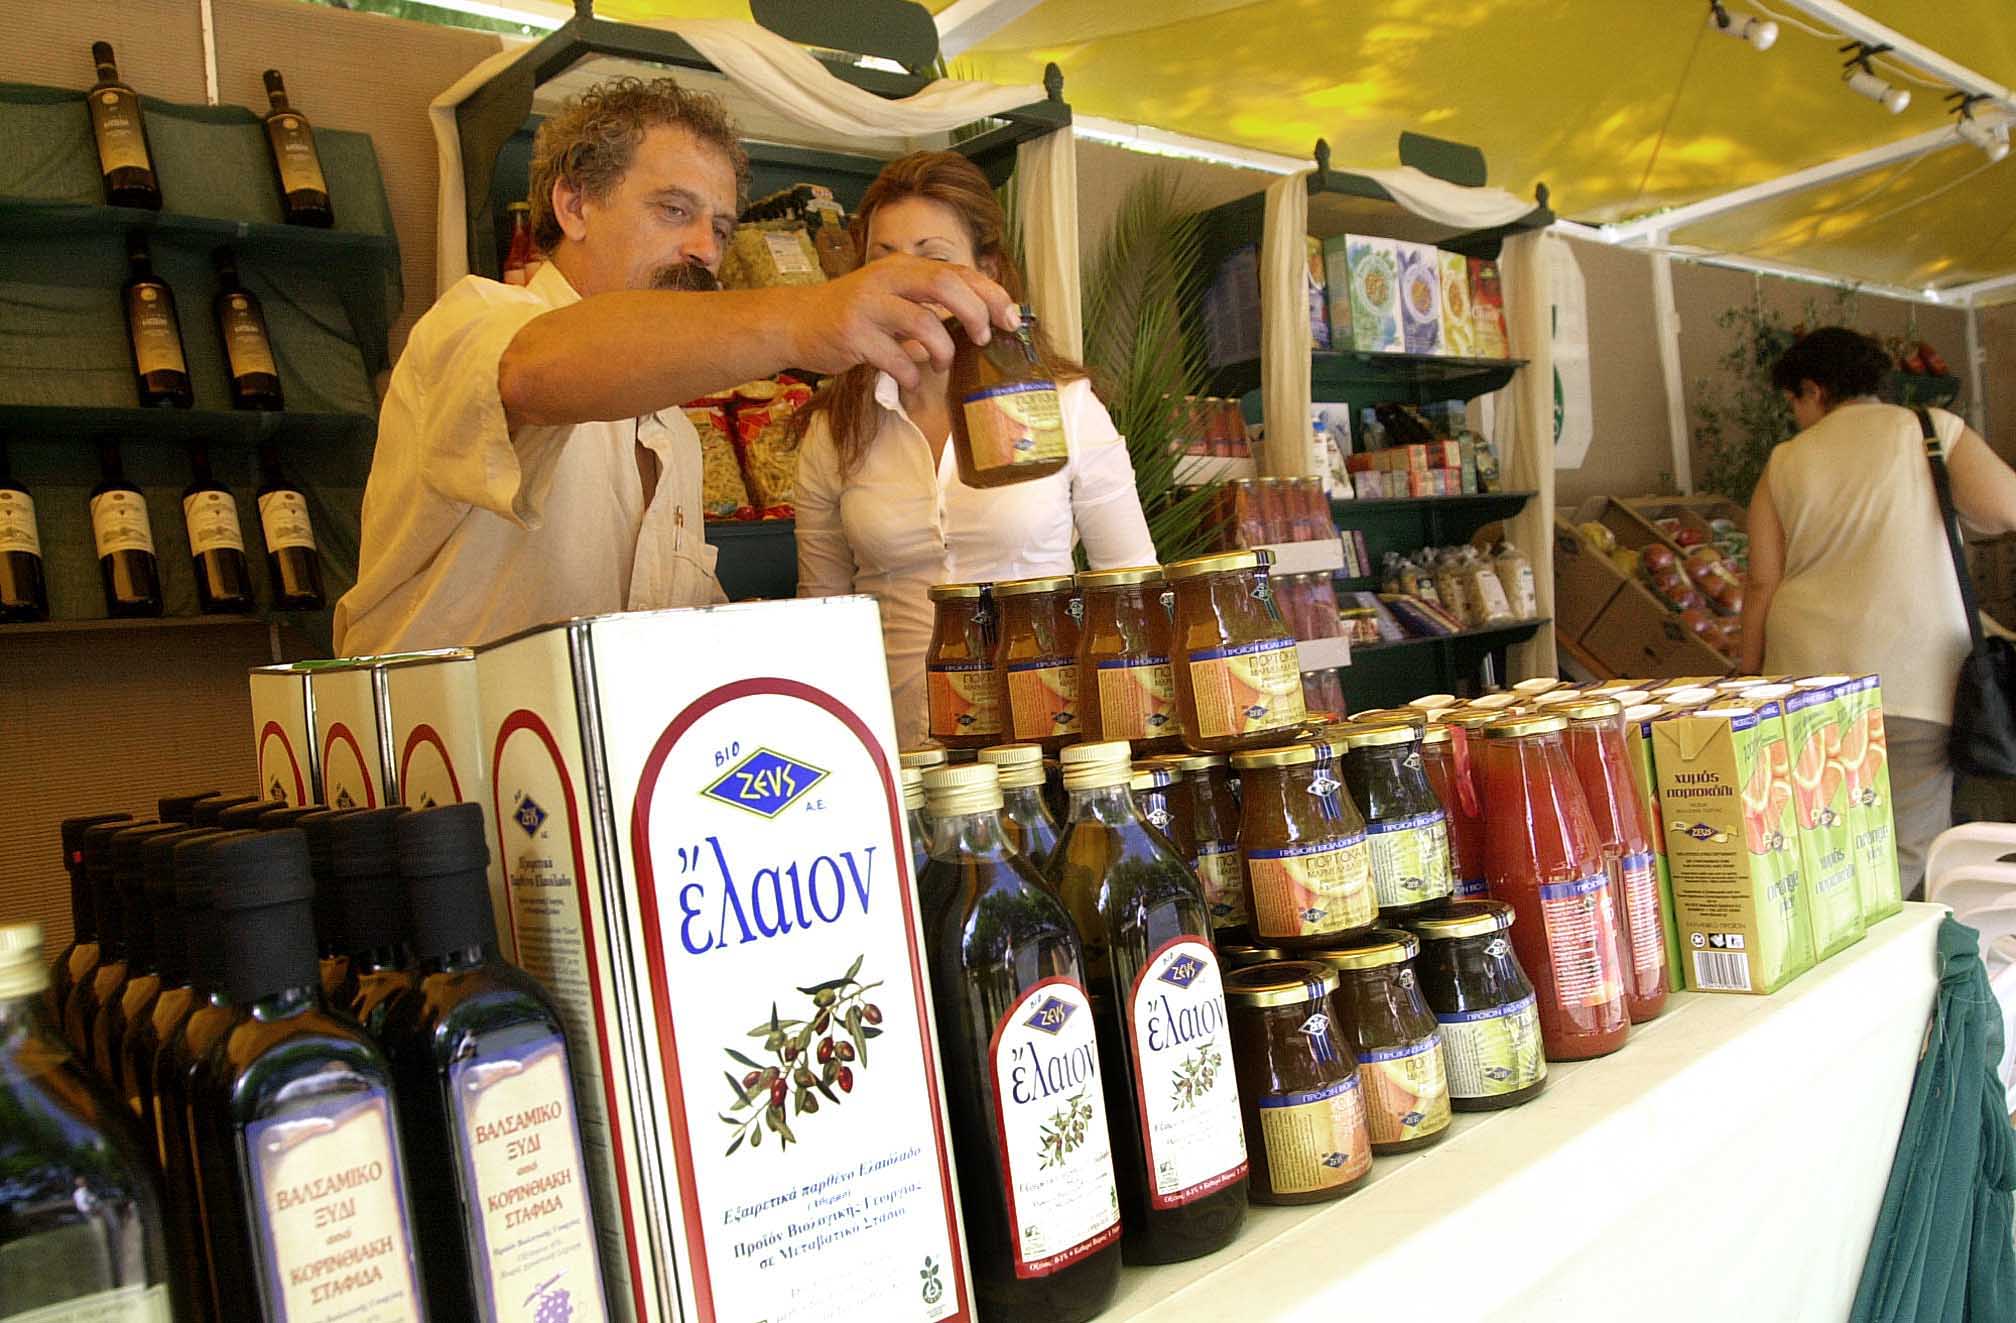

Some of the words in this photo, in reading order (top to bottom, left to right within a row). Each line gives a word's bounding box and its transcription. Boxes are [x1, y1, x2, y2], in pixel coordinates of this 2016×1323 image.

[475, 1101, 562, 1145] ΒΑΛΣΑΜΙΚΟ
[505, 1134, 542, 1161] ΞΥΔΙ
[276, 1160, 383, 1212] ΒΑΛΣΑΜΙΚΟ
[488, 1168, 572, 1213] ΚΟΡΙΝΘΙΑΚΗ
[314, 1197, 357, 1229] ΞΥΔΙ
[504, 1195, 564, 1230] ΣΤΑΦΙΔΑ
[289, 1234, 394, 1287] ΚΟΡΙΝΘΙΑΚΗ
[310, 1264, 384, 1305] ΣΤΑΦΙΔΑ
